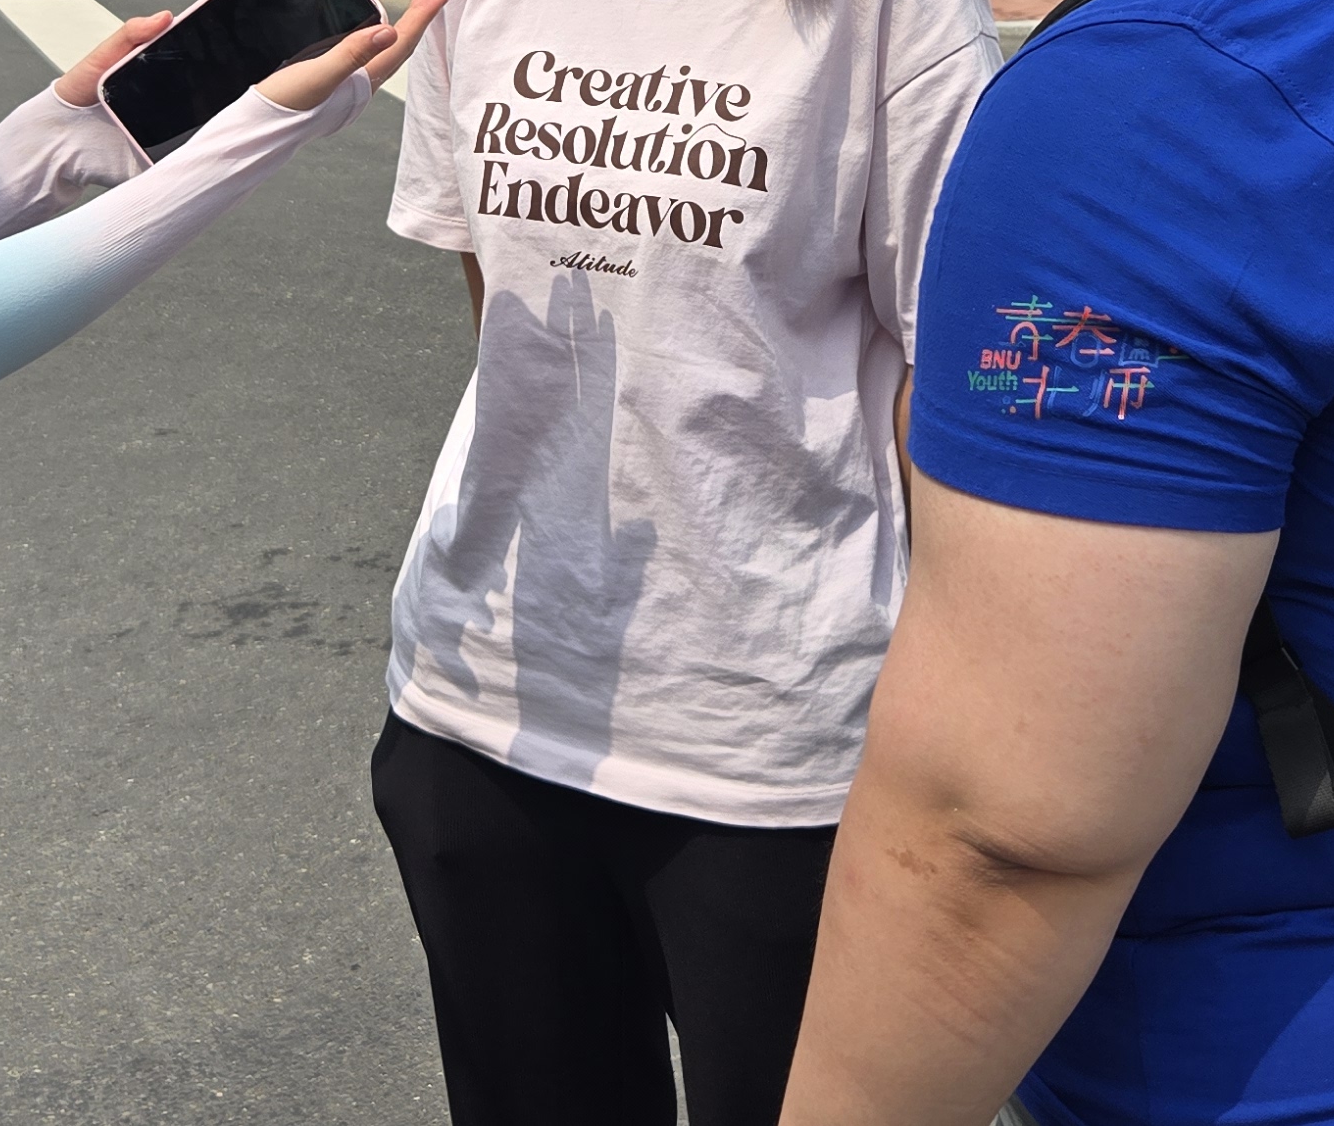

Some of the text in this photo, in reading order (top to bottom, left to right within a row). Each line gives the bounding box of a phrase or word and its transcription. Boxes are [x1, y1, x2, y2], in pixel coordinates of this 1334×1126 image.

[513, 50, 752, 122] Creative
[473, 102, 769, 192] Resolution
[477, 160, 745, 249] Endeavor
[967, 370, 1018, 392] Youth
[979, 349, 1022, 370] BNU
